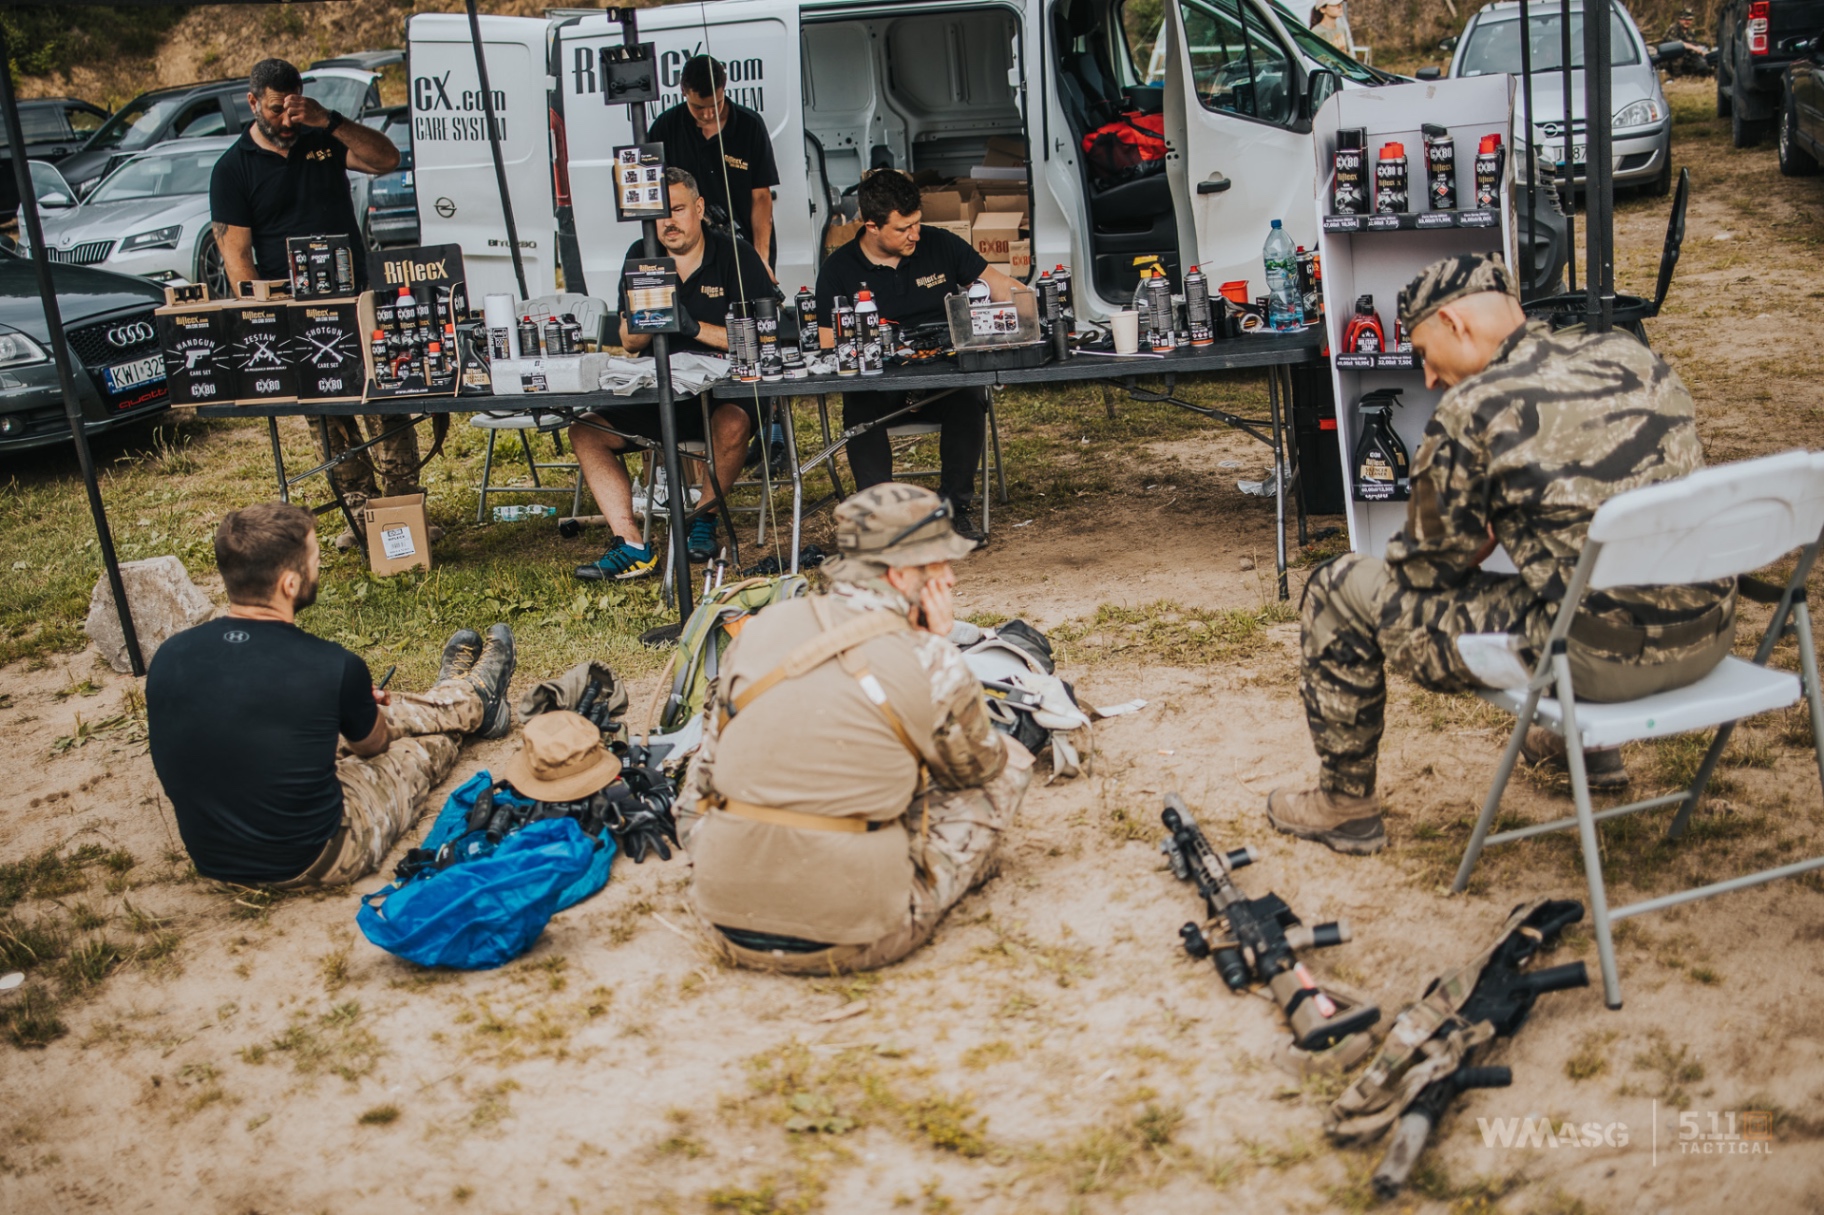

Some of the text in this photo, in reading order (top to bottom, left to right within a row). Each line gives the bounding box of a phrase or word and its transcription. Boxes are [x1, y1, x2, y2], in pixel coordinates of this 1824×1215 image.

[415, 117, 507, 141] CARE SYSTM
[1430, 146, 1452, 161] CX80
[1336, 155, 1359, 170] CX80
[1476, 161, 1496, 174] CX80
[1377, 165, 1396, 178] CX80
[978, 238, 1009, 256] CX80
[305, 326, 343, 338] SHOTGUN
[757, 319, 777, 333] CX80
[176, 339, 216, 350] HANDGUN
[244, 333, 276, 345] ZESTAW
[112, 363, 141, 387] KWI
[191, 382, 216, 397] CX80
[255, 378, 280, 393] CX80
[318, 377, 343, 392] CX80
[119, 388, 168, 409] quattr
